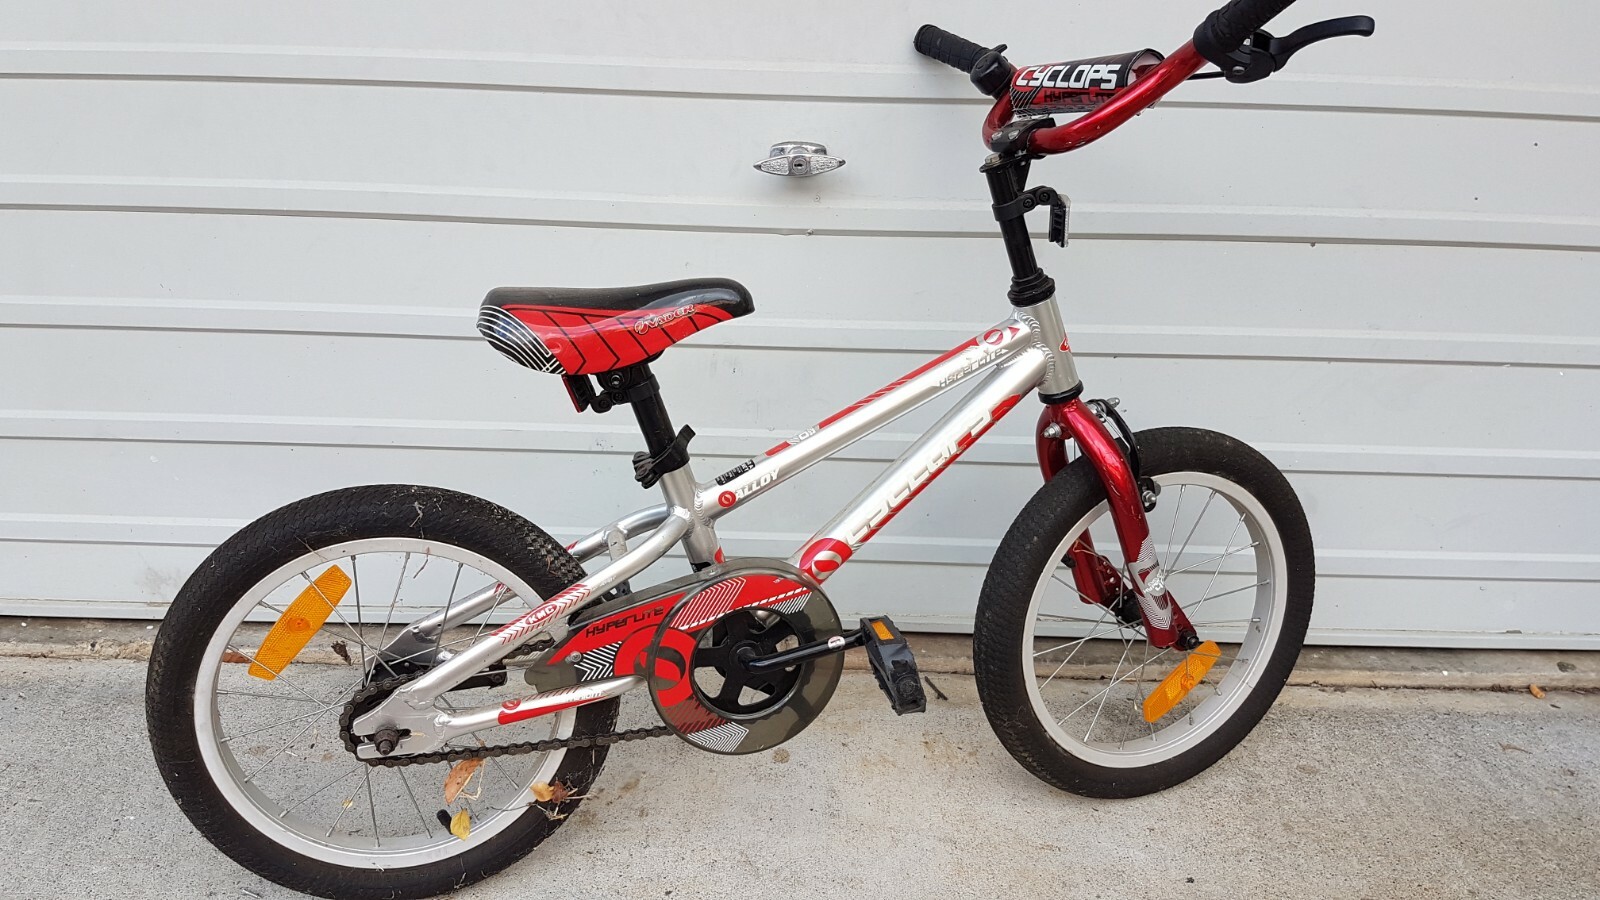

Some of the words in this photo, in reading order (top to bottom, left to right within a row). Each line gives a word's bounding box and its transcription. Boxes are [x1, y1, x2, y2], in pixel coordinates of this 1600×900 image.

[1015, 64, 1121, 89] CYCLOPS
[736, 467, 780, 499] ALLOY
[528, 605, 555, 624] KMC
[585, 606, 664, 638] HYPERLITE
